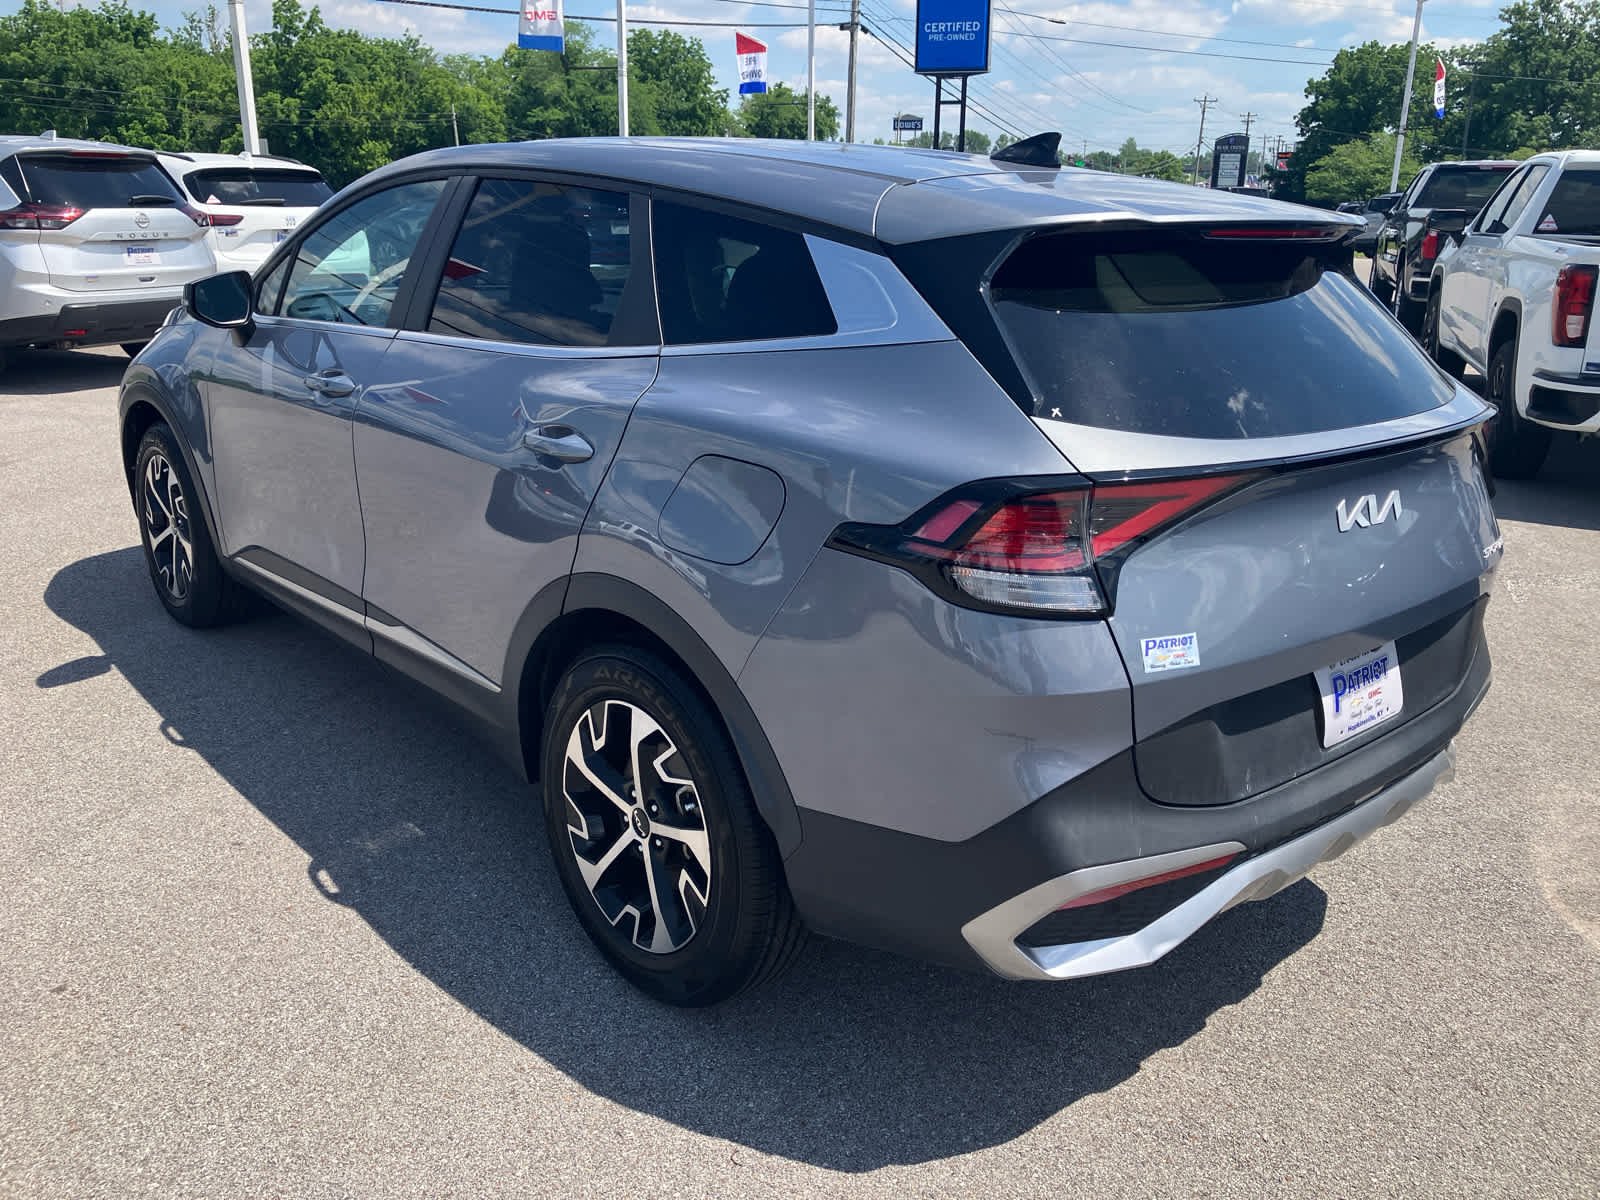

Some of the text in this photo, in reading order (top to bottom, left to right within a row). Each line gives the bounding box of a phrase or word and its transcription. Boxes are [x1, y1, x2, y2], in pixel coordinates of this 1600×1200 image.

[924, 20, 981, 33] CERTIFIED
[928, 32, 976, 41] PRE-OWNED
[894, 120, 921, 129] LOWE'S
[1336, 489, 1402, 533] KIA
[1144, 635, 1194, 657] PATRIOT
[1332, 657, 1388, 713] PATRIOT
